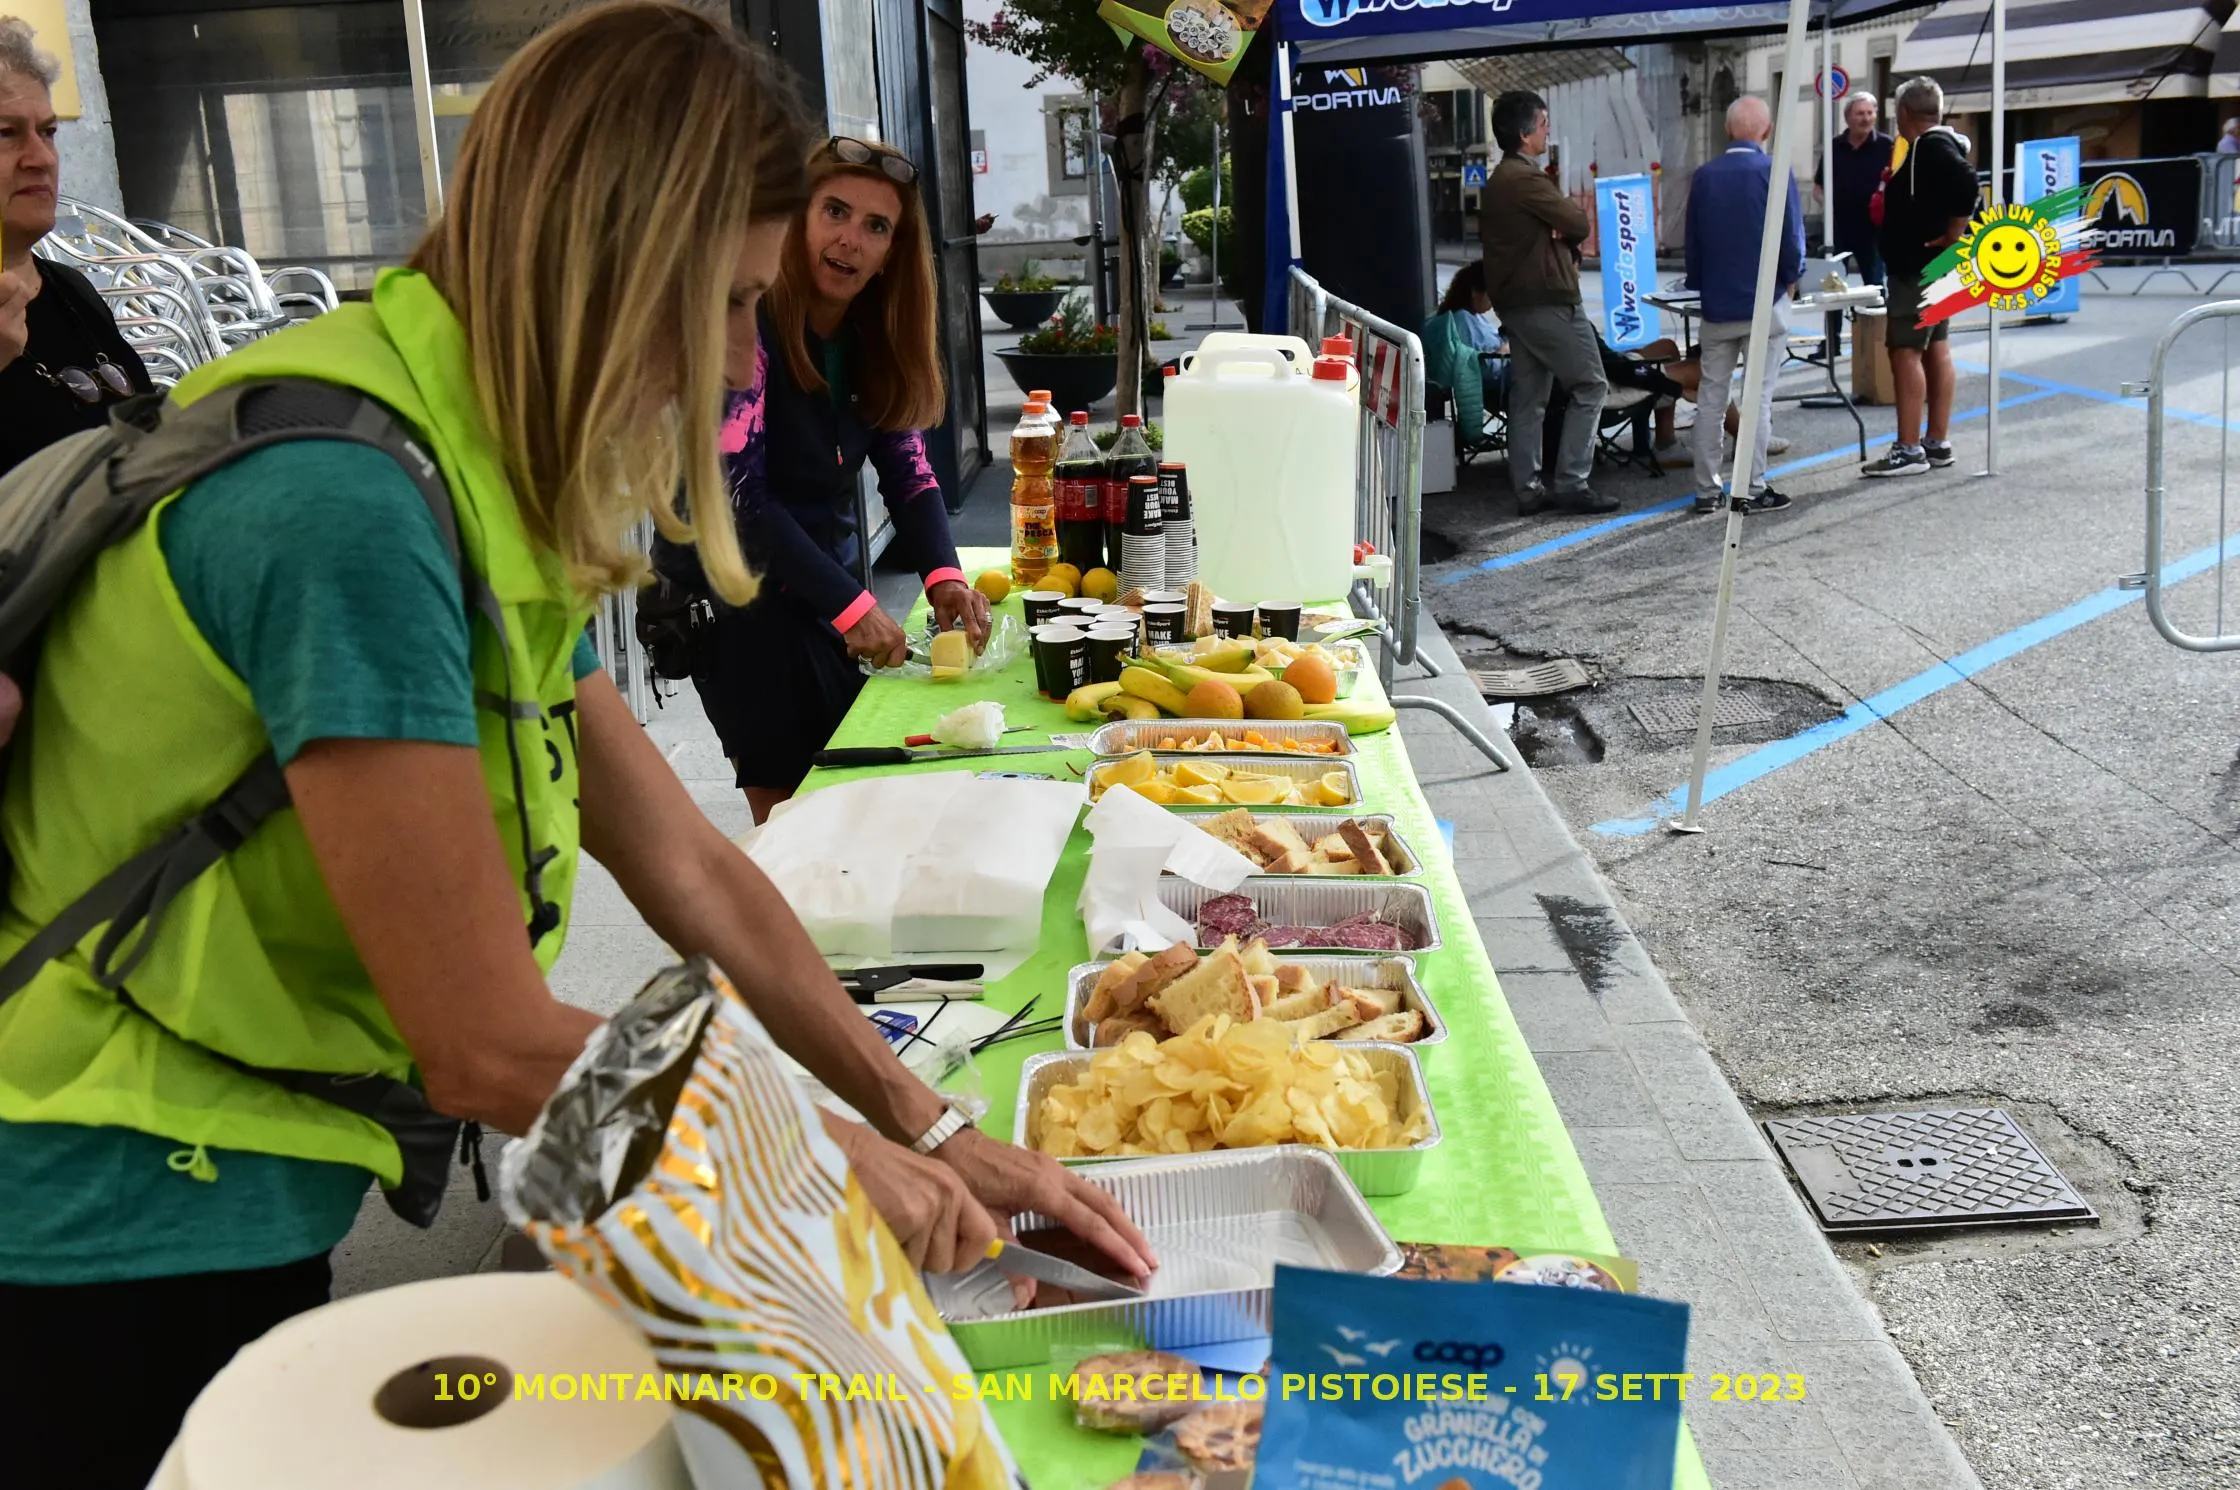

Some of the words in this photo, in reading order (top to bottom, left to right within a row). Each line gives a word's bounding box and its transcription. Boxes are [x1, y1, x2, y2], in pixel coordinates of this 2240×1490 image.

[1292, 86, 1402, 112] PORTIVA
[1160, 496, 1178, 504] MAK
[1413, 1341, 1505, 1373] coop
[1403, 1409, 1533, 1455] GRANELLA
[1393, 1436, 1543, 1490] ZUCCHERO
